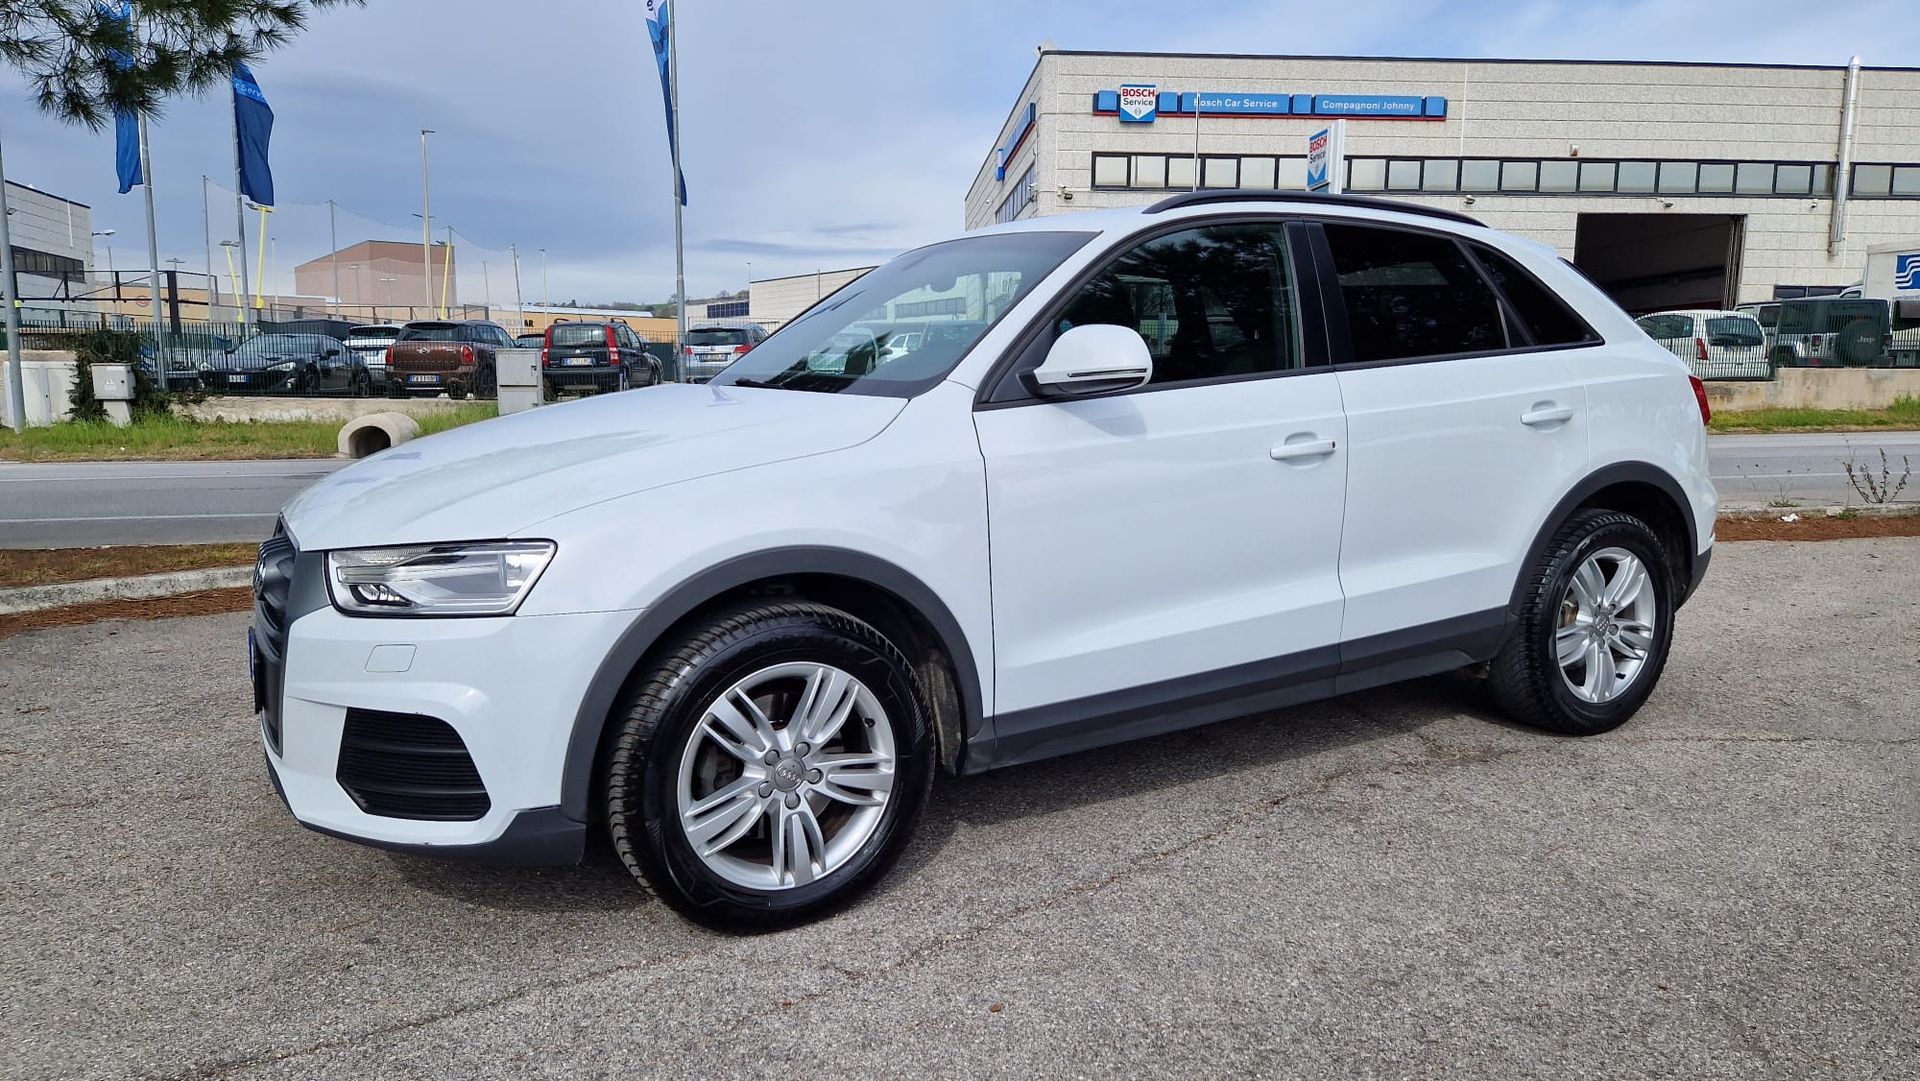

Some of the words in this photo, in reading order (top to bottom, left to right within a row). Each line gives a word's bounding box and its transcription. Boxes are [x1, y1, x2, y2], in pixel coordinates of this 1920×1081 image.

[1122, 88, 1155, 98] BOSCH
[1123, 98, 1153, 106] Service
[1225, 98, 1240, 107] Car
[1243, 98, 1278, 108] Service
[1322, 100, 1380, 110] Compagnoni
[1382, 101, 1415, 111] Johnny
[1309, 135, 1328, 153] BOSCH
[1309, 150, 1326, 164] Service
